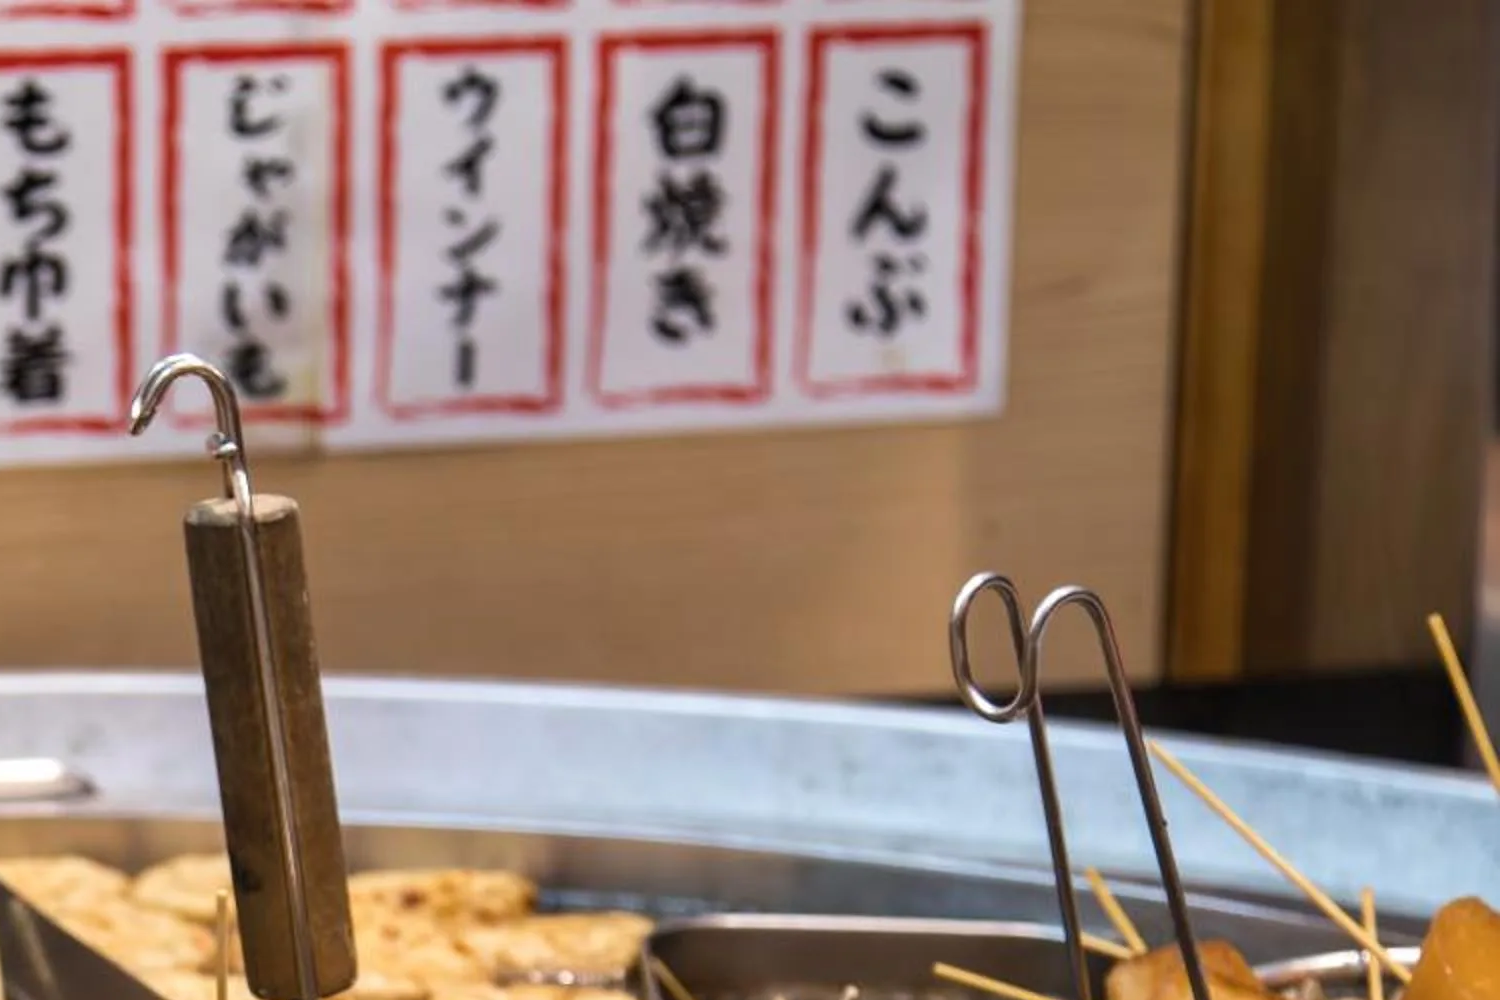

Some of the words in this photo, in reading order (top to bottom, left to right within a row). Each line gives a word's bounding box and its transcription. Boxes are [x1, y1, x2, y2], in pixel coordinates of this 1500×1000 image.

[221, 74, 293, 399] じゃがいも
[641, 76, 728, 344] 白焼き
[846, 68, 928, 337] こんぶ
